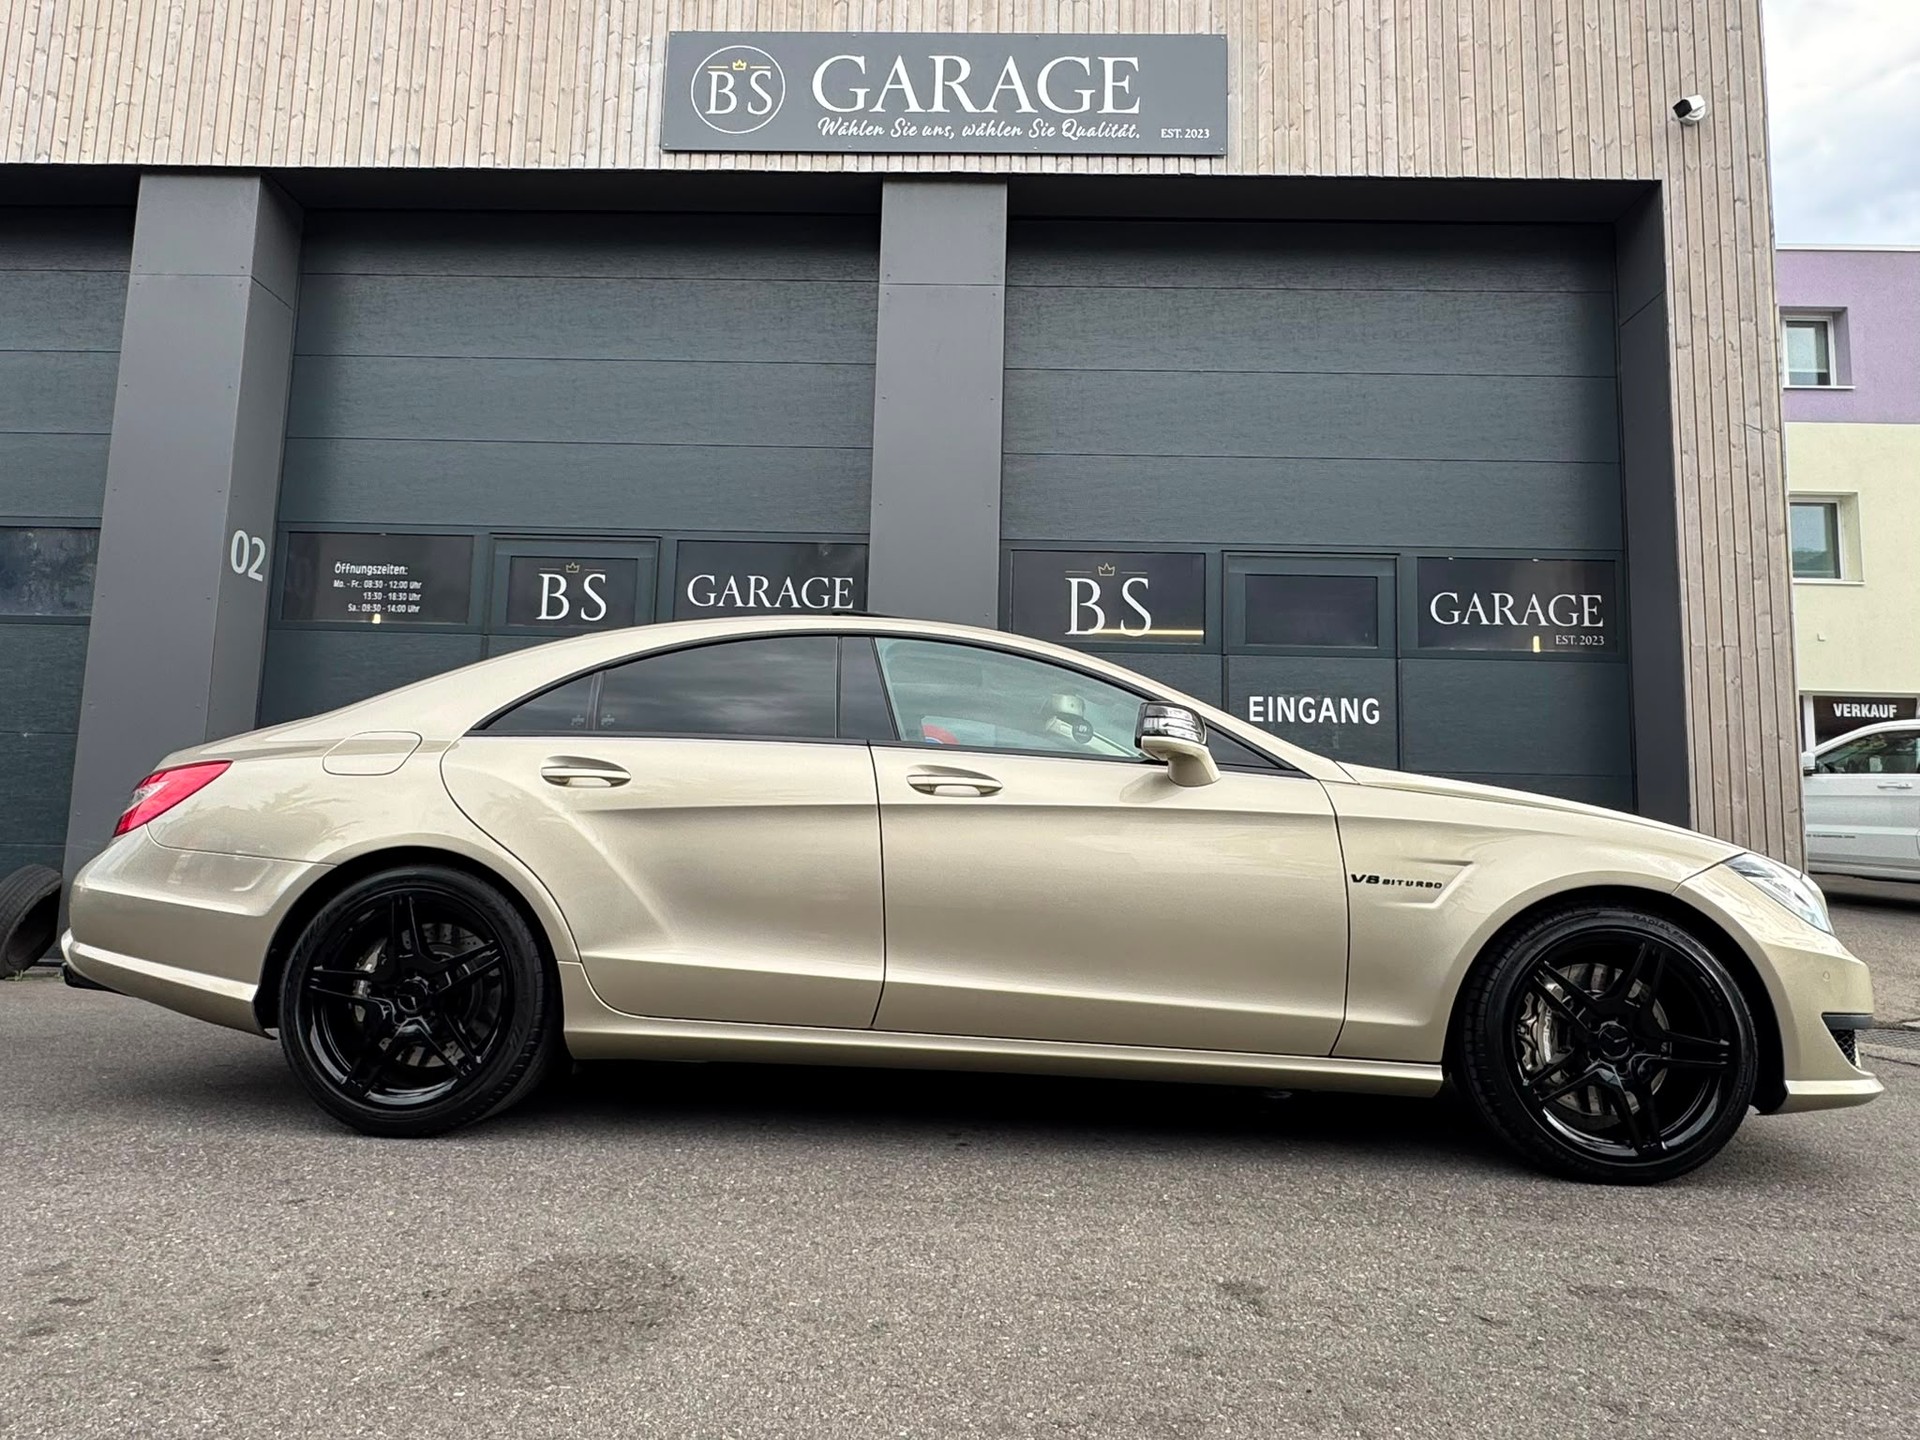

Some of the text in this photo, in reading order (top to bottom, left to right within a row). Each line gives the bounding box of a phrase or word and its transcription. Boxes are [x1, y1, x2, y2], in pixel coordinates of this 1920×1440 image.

[811, 54, 1140, 114] GARAGE
[817, 116, 1141, 141] Wählen Sie uns, wählen Sie Qualität.
[1160, 128, 1210, 140] EST. 2023
[230, 530, 266, 582] 02
[334, 562, 408, 576] Öffnungszeiten:
[389, 580, 408, 589] 12:00
[409, 581, 422, 590] Uhr
[687, 574, 855, 609] GARAGE
[363, 592, 382, 601] 13:30
[388, 592, 407, 601] 18:30
[408, 593, 421, 601] Uhr
[387, 603, 406, 613] 14:00
[407, 604, 420, 613] Uhr
[1430, 592, 1604, 628] GARAGE
[1554, 635, 1605, 646] EST. 2023
[1248, 696, 1380, 725] EINGANG
[1833, 703, 1897, 718] VERKAUF
[1351, 874, 1443, 889] V8 BITURBO
